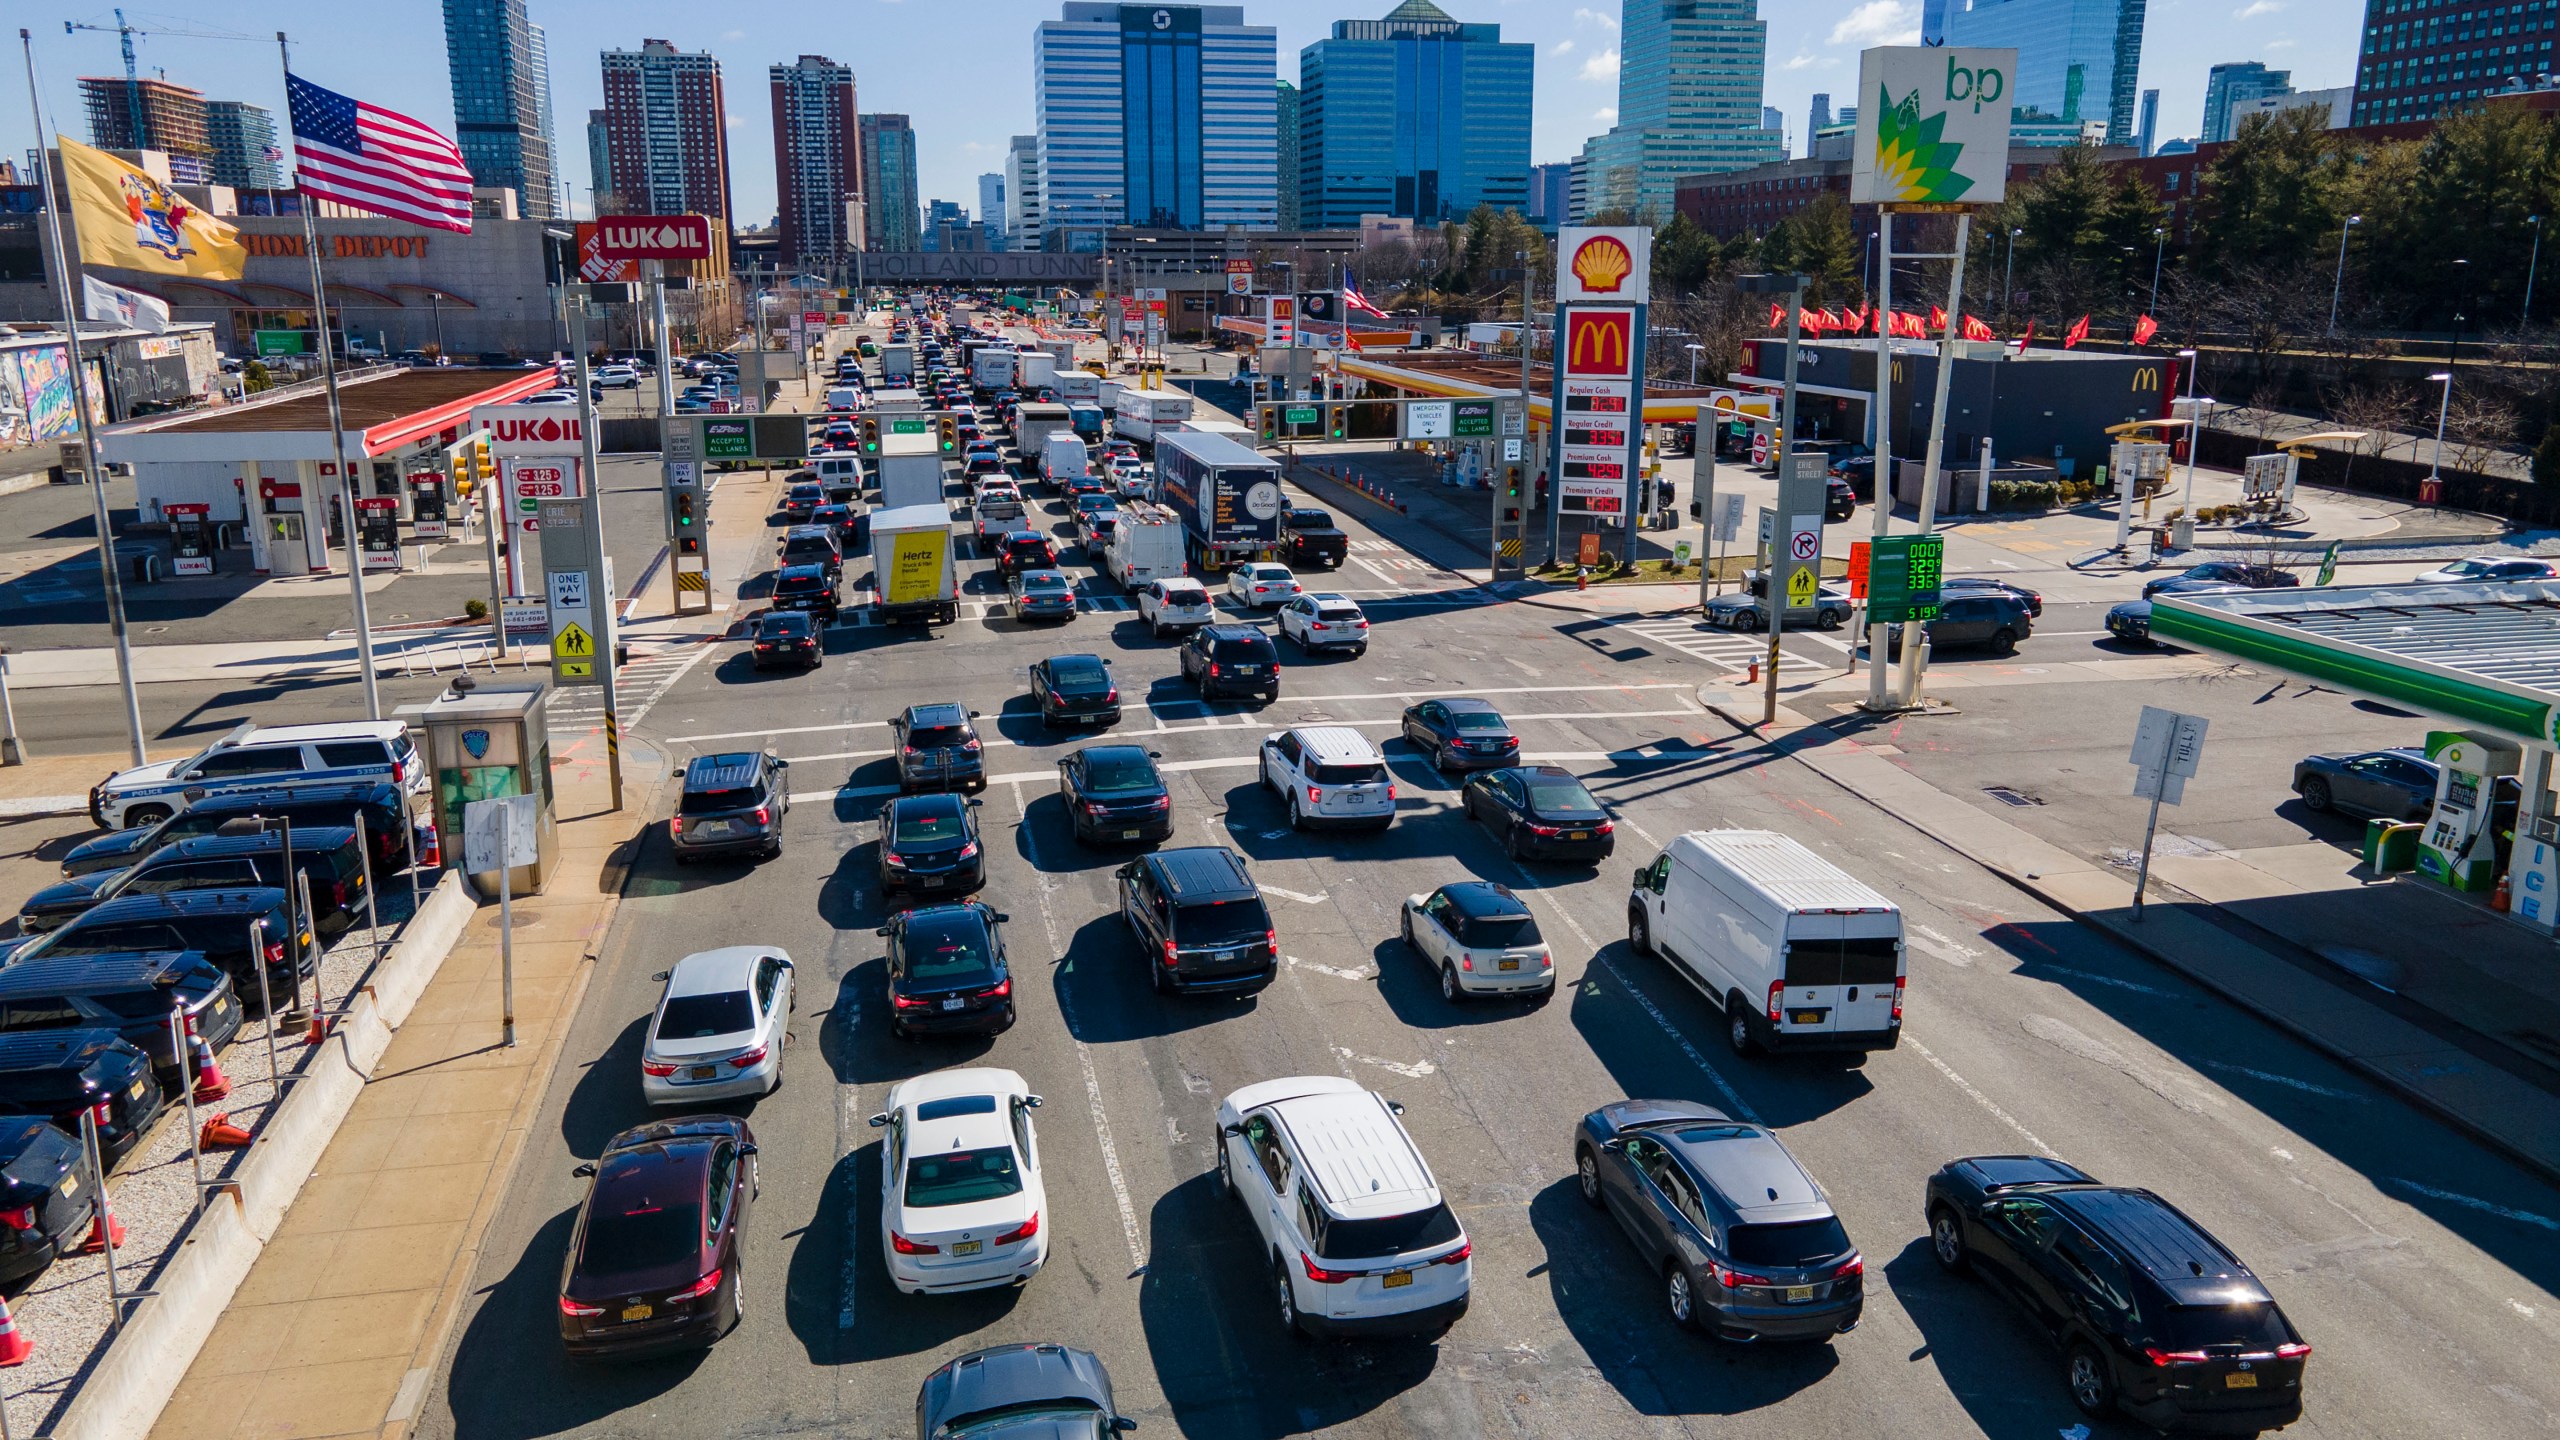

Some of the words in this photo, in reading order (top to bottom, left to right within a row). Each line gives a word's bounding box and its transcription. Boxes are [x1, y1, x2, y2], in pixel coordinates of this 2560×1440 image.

[1945, 56, 2003, 114] bp
[333, 235, 429, 258] DEPOT
[866, 256, 998, 276] HOLLAND
[1569, 386, 1593, 395] Regular
[1568, 420, 1592, 429] Regular
[1594, 420, 1613, 428] Credit
[1567, 453, 1594, 461] Premium
[1797, 461, 1812, 469] ERIE
[533, 469, 552, 481] 3.25
[1797, 470, 1821, 478] STREET
[534, 484, 553, 495] 3.25
[1565, 486, 1593, 494] Premium
[1594, 487, 1614, 495] Credit
[546, 507, 565, 516] ERIE
[546, 519, 579, 527] STREET
[1763, 515, 1771, 523] ONE
[1762, 522, 1771, 530] WAY
[903, 551, 932, 561] Hertz
[1364, 559, 1439, 571] FIRE
[558, 575, 579, 583] ONE
[559, 585, 580, 593] WAY
[132, 788, 163, 797] POLICE
[2521, 844, 2545, 920] ICE
